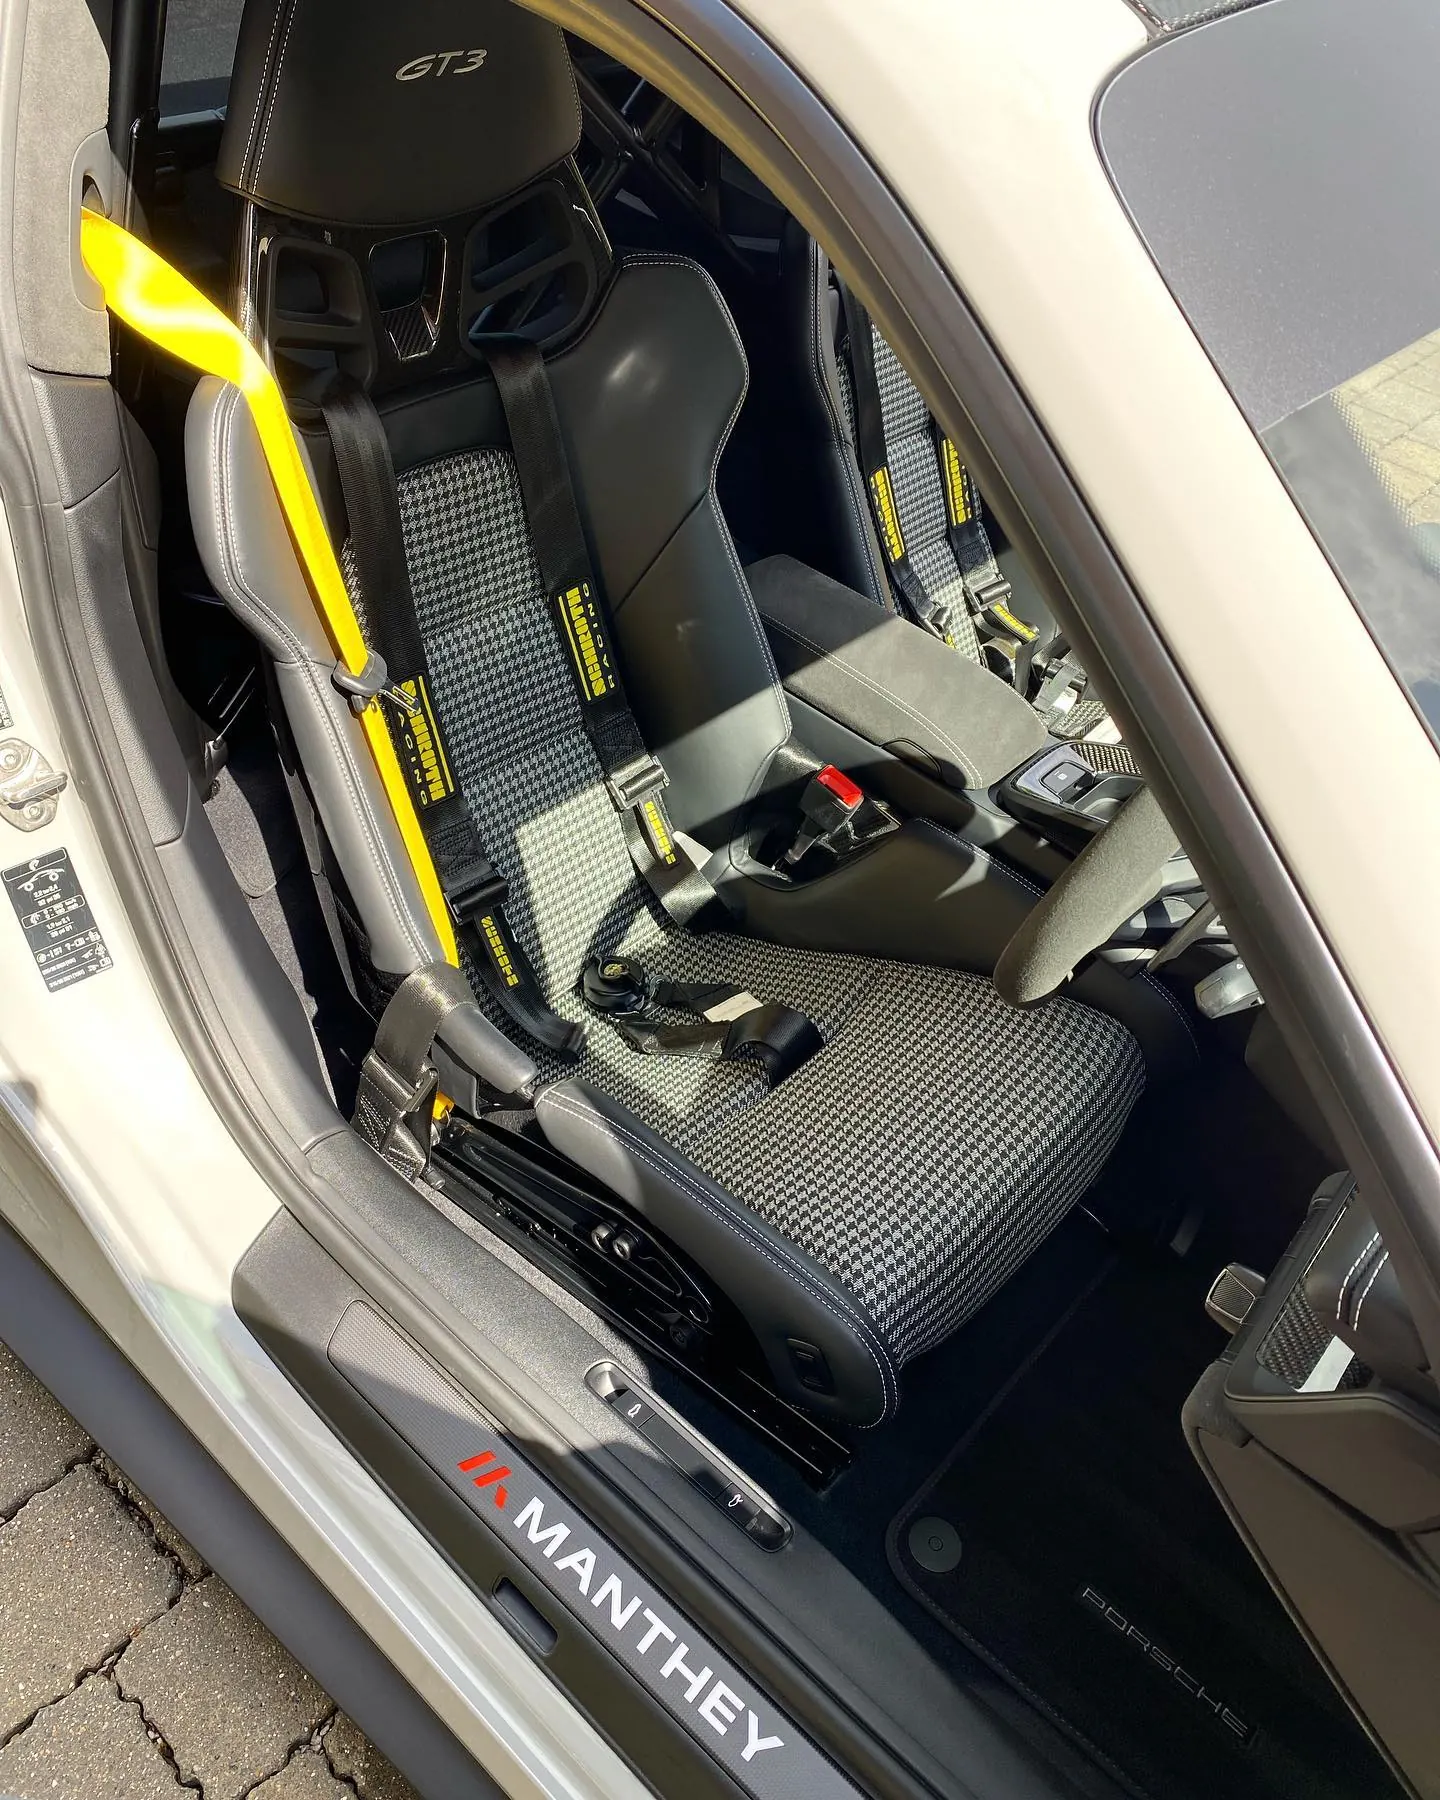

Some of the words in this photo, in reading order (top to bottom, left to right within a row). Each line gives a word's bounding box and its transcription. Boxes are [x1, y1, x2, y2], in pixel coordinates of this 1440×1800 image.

[395, 49, 488, 80] GT3
[565, 586, 607, 697] SCHROTH
[582, 582, 615, 689] RACING
[481, 915, 519, 987] SCHROTH
[512, 1495, 785, 1762] MANTHEY
[1082, 1587, 1248, 1738] PORSCHE
